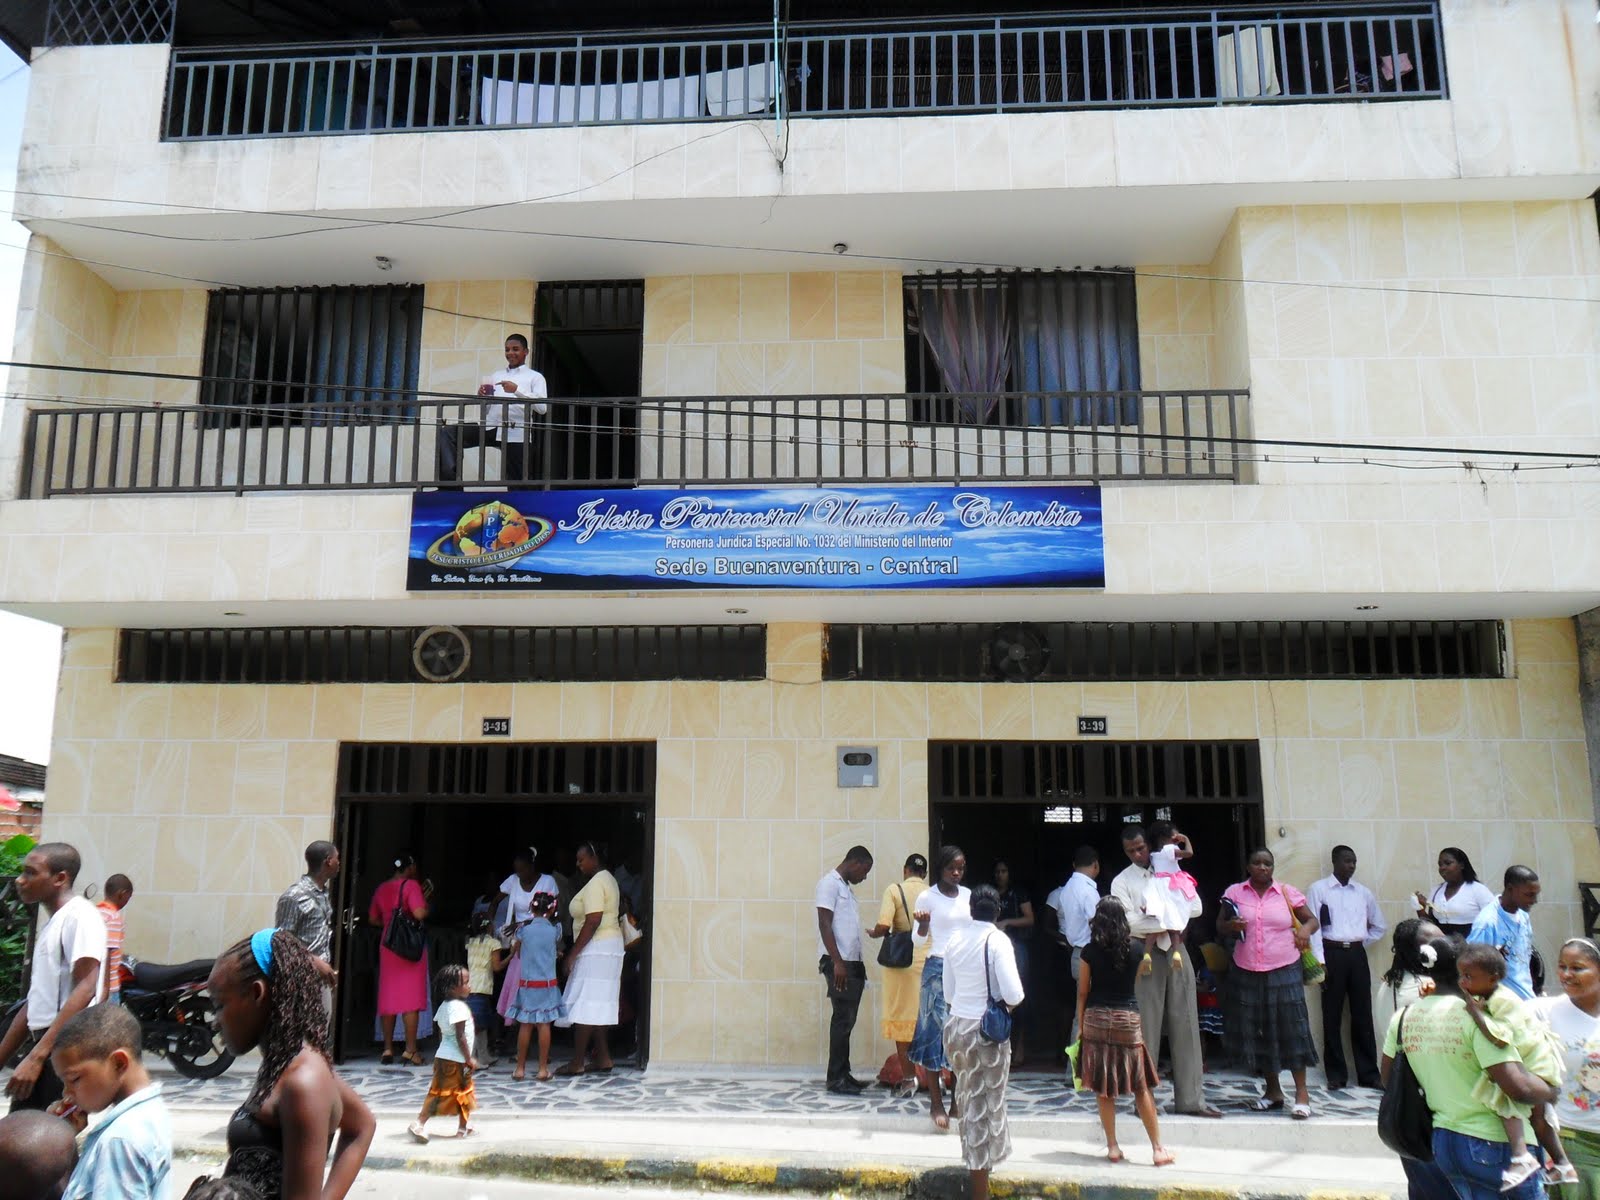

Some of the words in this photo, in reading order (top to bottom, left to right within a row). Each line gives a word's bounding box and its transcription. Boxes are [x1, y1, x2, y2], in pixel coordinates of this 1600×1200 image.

[558, 498, 655, 544] Iglesia
[659, 496, 810, 530] Pentecostal
[812, 494, 910, 530] Unida
[912, 501, 945, 528] de
[952, 492, 1083, 528] Colombia
[755, 534, 794, 550] Especial
[796, 535, 811, 547] No.
[814, 535, 835, 547] 1032
[837, 534, 852, 547] del
[854, 534, 899, 547] Ministerio
[901, 534, 916, 547] del
[918, 534, 953, 547] Interior
[655, 557, 707, 575] Sede
[714, 556, 861, 575] Buenaventura
[879, 555, 959, 575] Central
